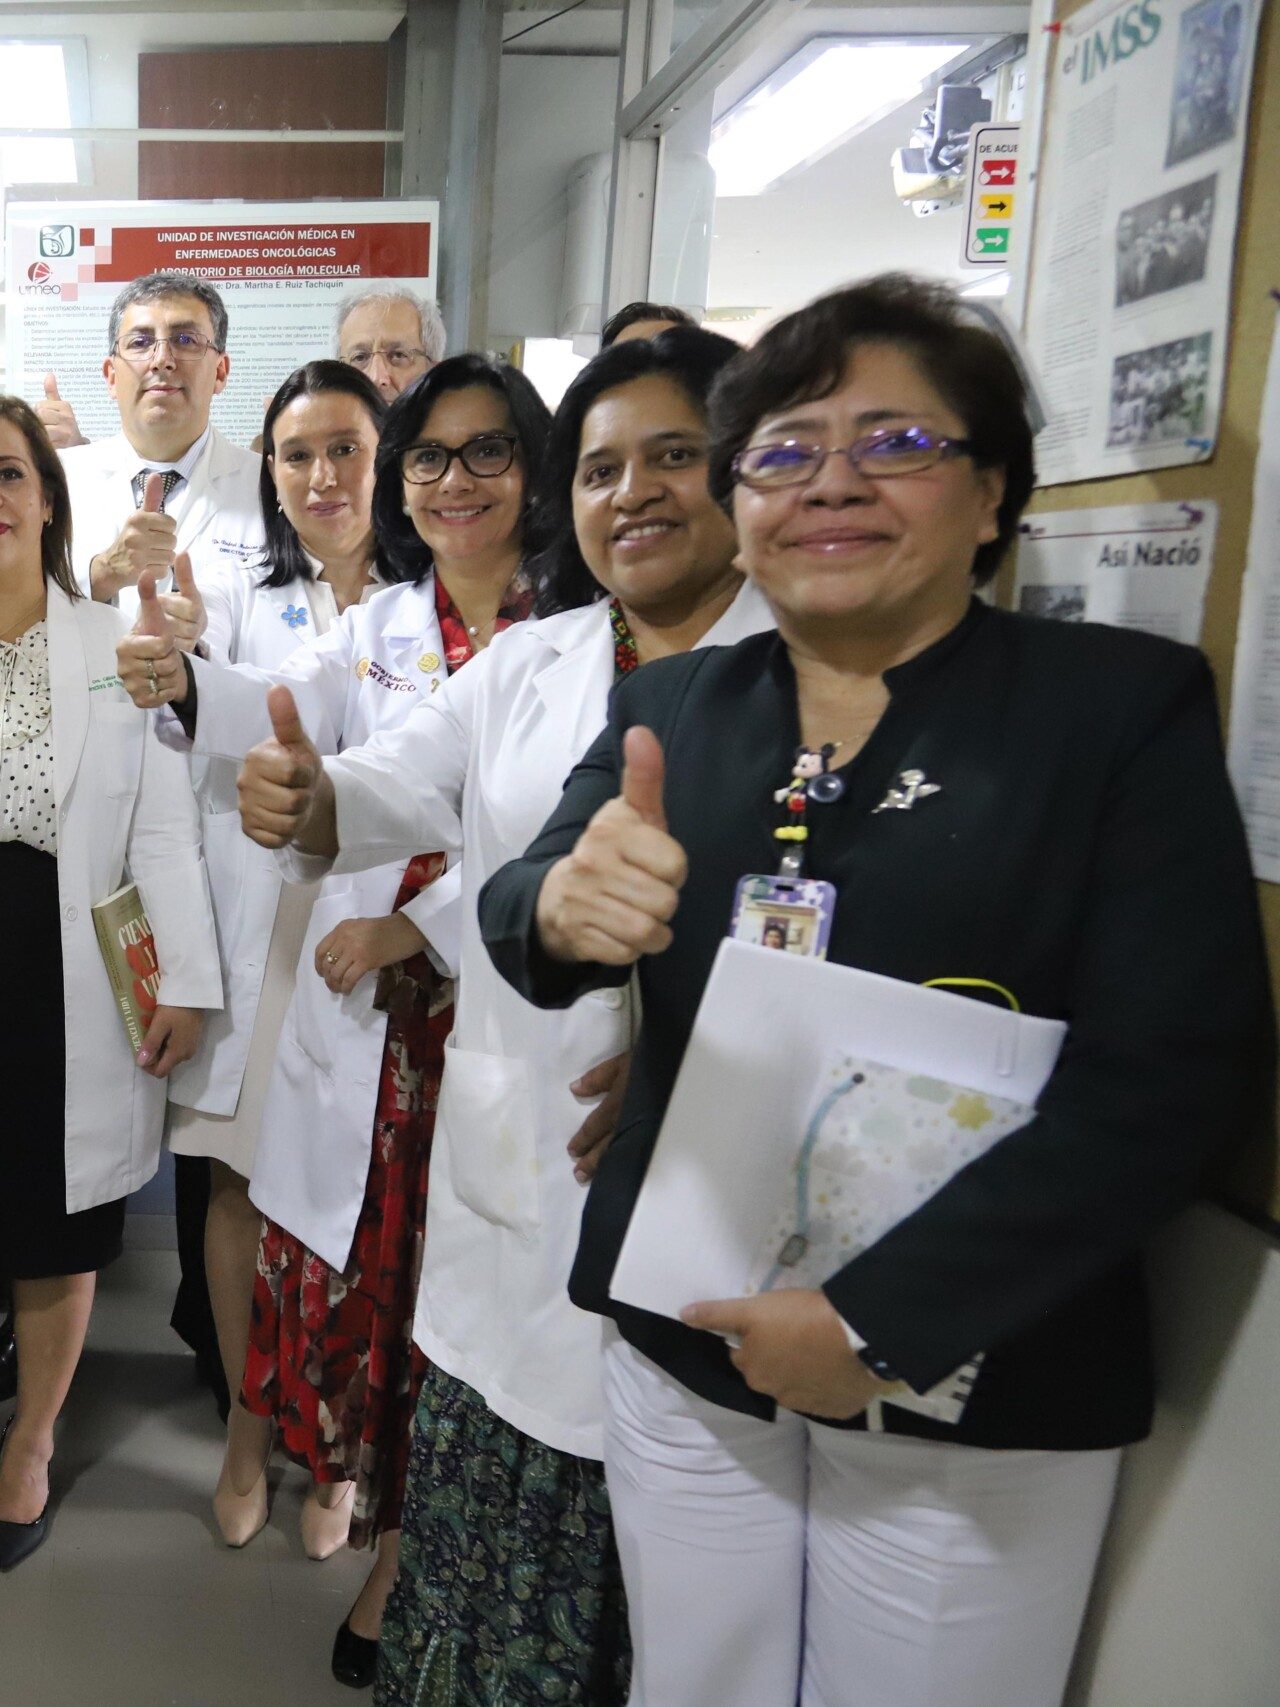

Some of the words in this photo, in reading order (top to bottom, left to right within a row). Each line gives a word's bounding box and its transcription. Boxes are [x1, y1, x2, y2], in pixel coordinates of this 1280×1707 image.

[1081, 0, 1161, 85] IMSS
[979, 145, 991, 153] DE
[157, 232, 197, 242] UNIDAD
[200, 231, 214, 242] DE
[216, 228, 294, 241] INVESTIGACIÓN
[297, 227, 338, 240] MÉDICA
[340, 229, 355, 239] EN
[175, 248, 260, 259] ENFERMEDADES
[262, 246, 336, 258] ONCOLÓGICAS
[229, 267, 243, 276] DE
[245, 264, 294, 275] BIOLOGÍA
[296, 264, 361, 275] MOLECULAR
[225, 282, 241, 290] Dra.
[244, 281, 274, 289] Martha
[276, 281, 283, 289] E.
[285, 281, 303, 289] Ruiz
[220, 548, 245, 556] DIRECTOR
[1133, 537, 1202, 567] Nació
